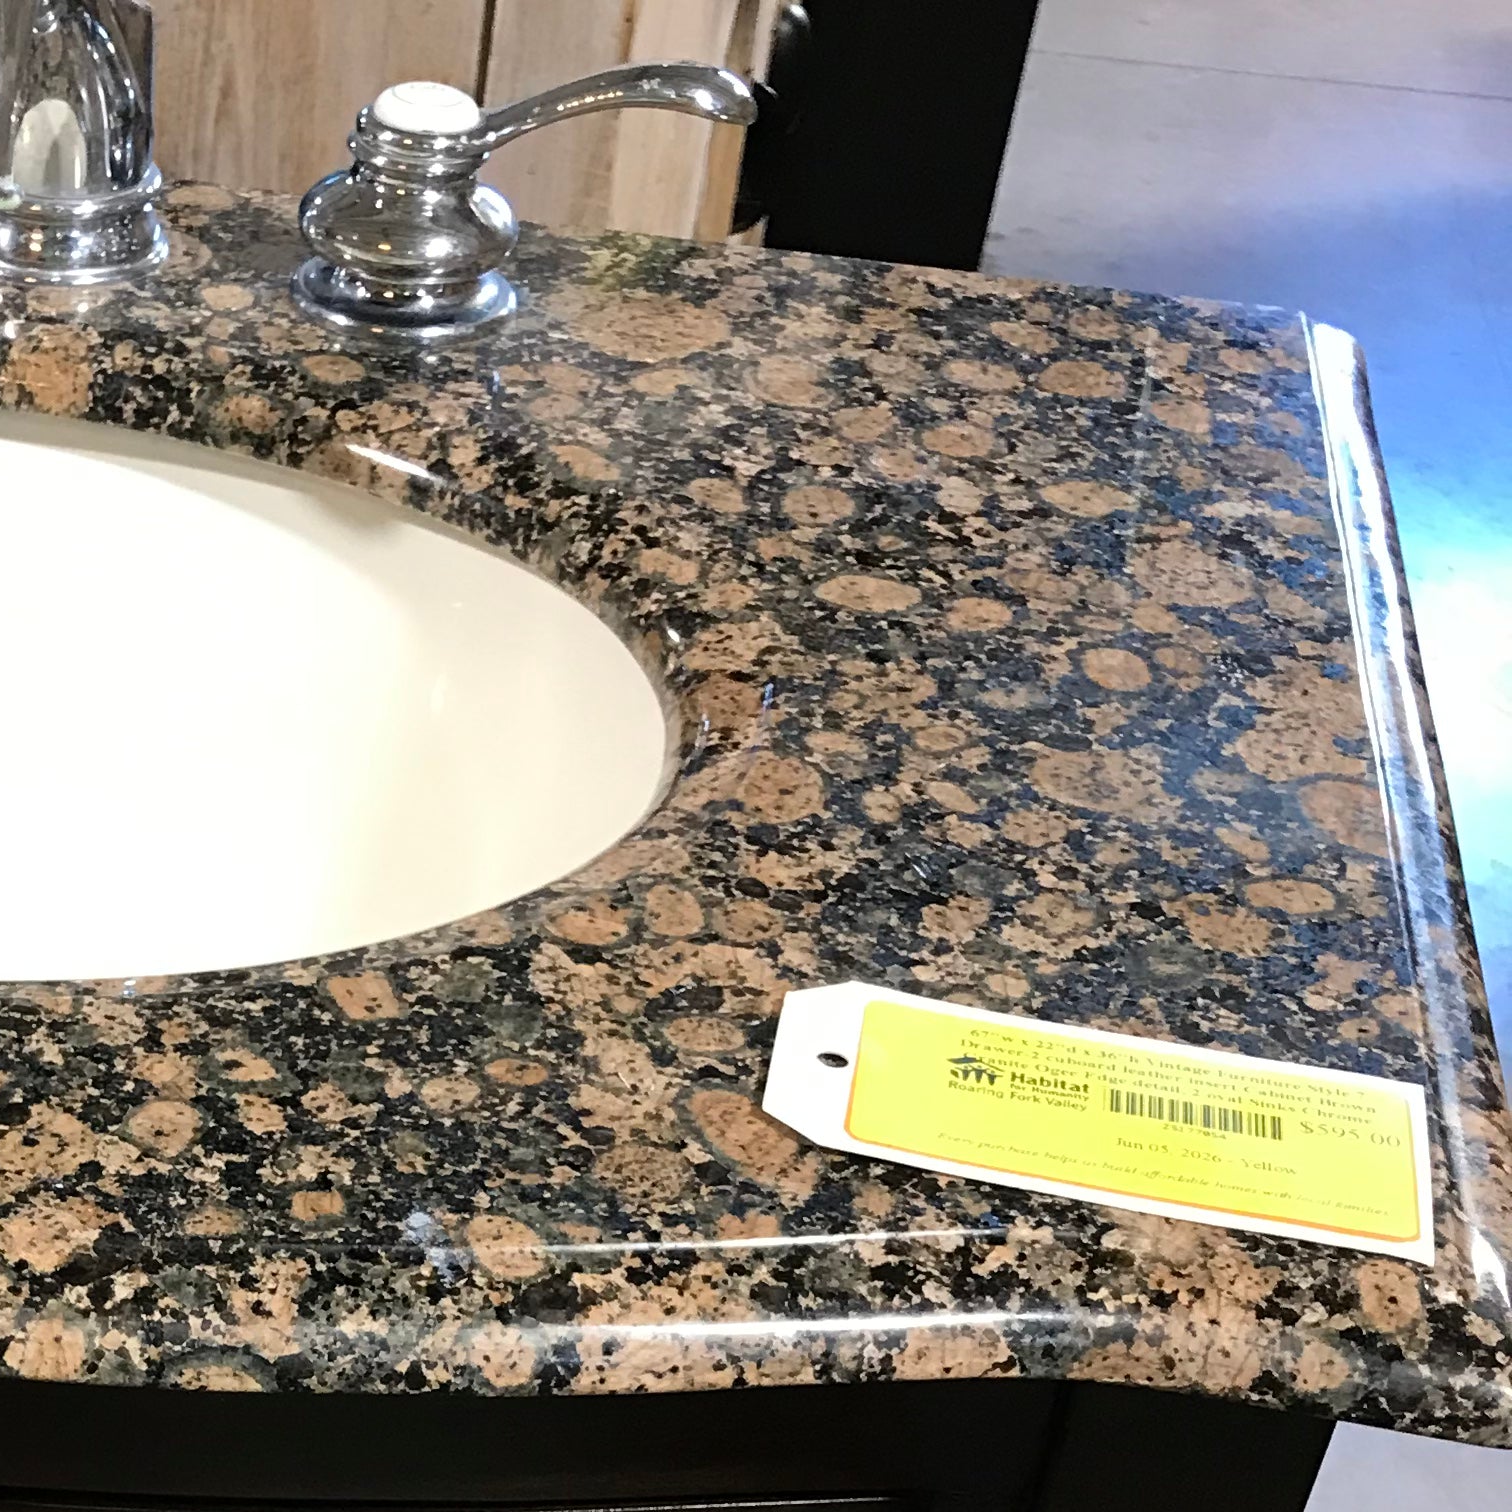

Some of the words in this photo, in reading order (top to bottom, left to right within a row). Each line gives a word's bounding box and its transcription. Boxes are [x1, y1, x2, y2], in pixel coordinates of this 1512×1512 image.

[948, 1080, 1004, 1099] Roaring
[1010, 1091, 1040, 1104] Fork
[1045, 1097, 1087, 1113] Valley
[1010, 1071, 1089, 1094] Habitat
[1010, 1083, 1026, 1091] for
[1031, 1086, 1089, 1102] Humanity
[1123, 1065, 1182, 1082] leather
[1189, 1077, 1236, 1091] insert
[1244, 1086, 1311, 1103] Cabinet
[1320, 1098, 1376, 1114] Brown
[1146, 1057, 1210, 1075] Vintage
[1218, 1070, 1300, 1090] Furniture
[1308, 1084, 1349, 1097] Style
[1084, 1070, 1127, 1085] Edge
[1208, 1094, 1243, 1104] oval
[1249, 1098, 1297, 1112] Sinks
[1302, 1107, 1370, 1124] Chrome
[937, 1132, 975, 1145] Every
[977, 1142, 1039, 1157] purchase
[1043, 1151, 1078, 1165] helps
[1102, 1161, 1138, 1174] build
[1140, 1169, 1210, 1186] affordable
[1215, 1180, 1257, 1194] homes
[1262, 1190, 1292, 1199] with
[1116, 1137, 1144, 1150] Jun
[1240, 1158, 1297, 1175] Yellow
